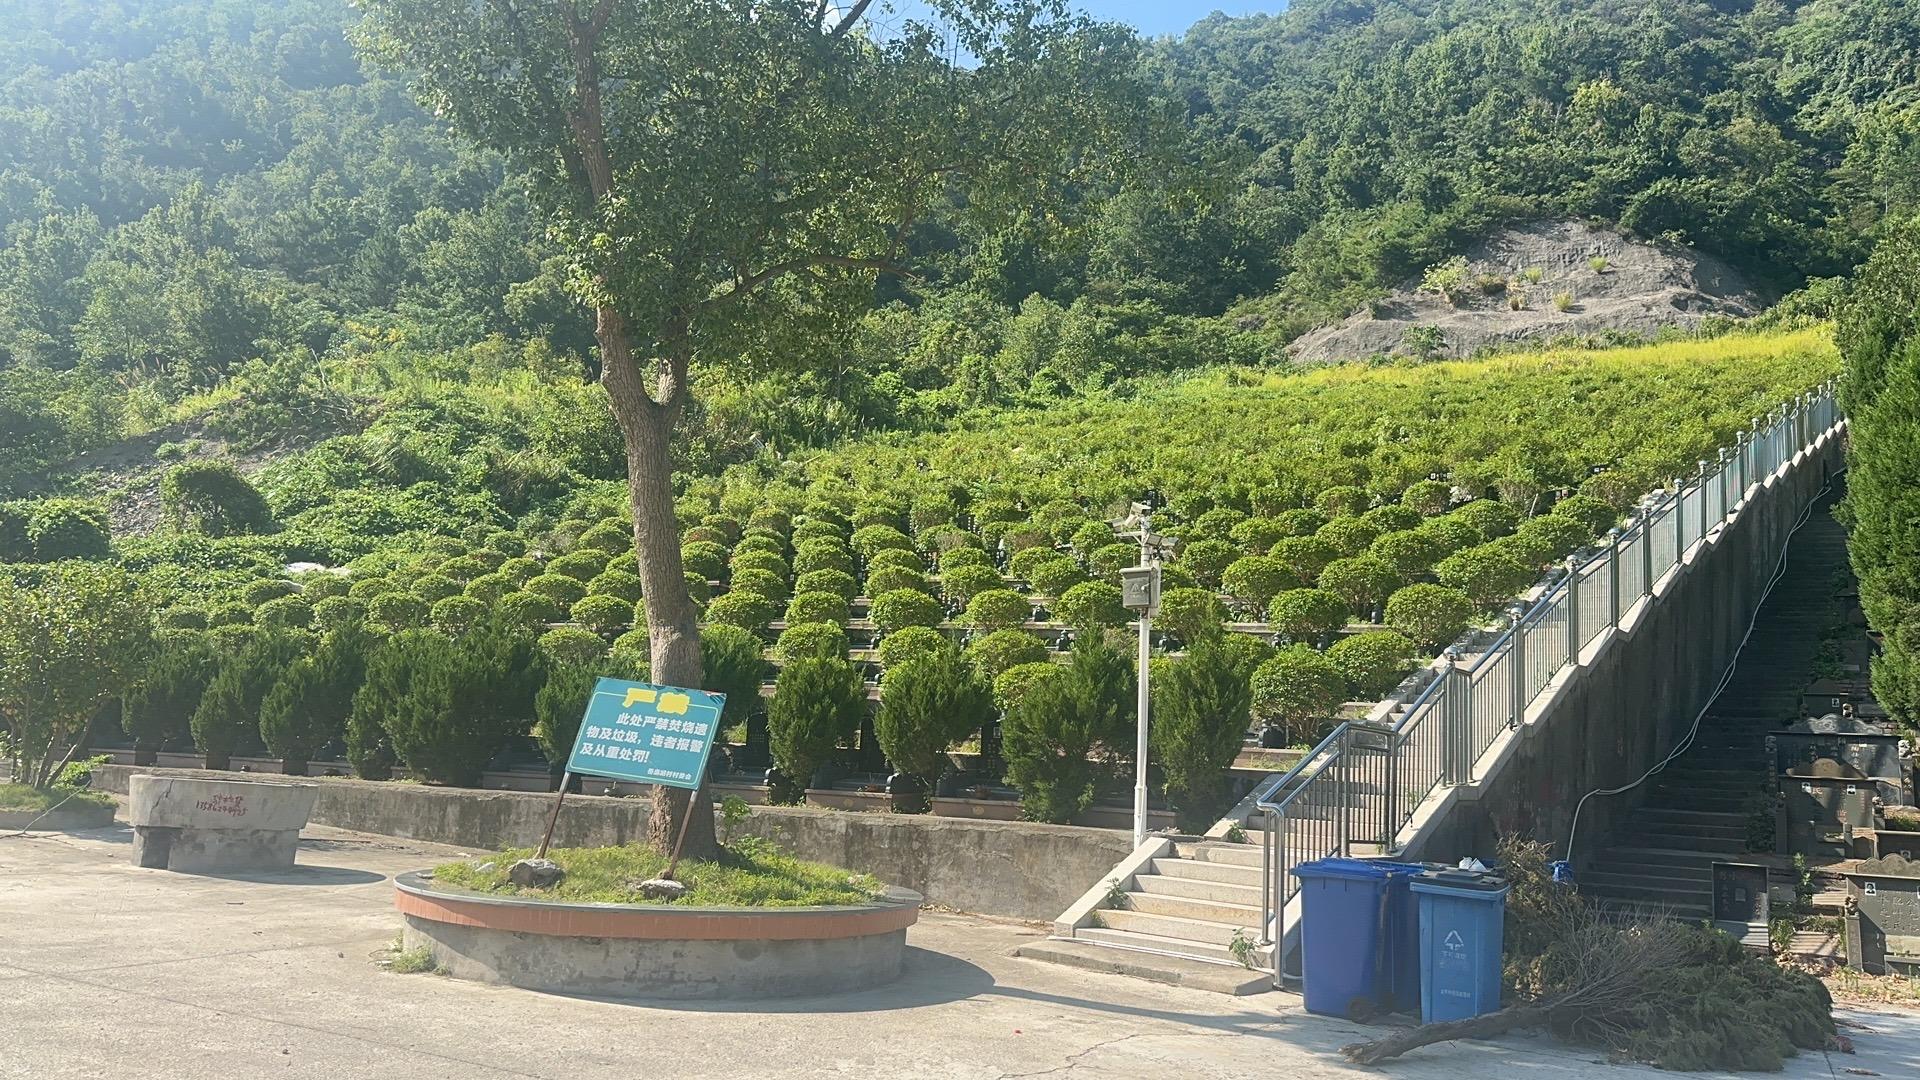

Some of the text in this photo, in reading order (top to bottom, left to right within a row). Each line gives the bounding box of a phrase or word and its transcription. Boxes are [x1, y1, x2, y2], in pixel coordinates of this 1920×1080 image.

[616, 713, 708, 736] 此处严禁焚烧遗
[580, 742, 650, 763] 及从重处罚！
